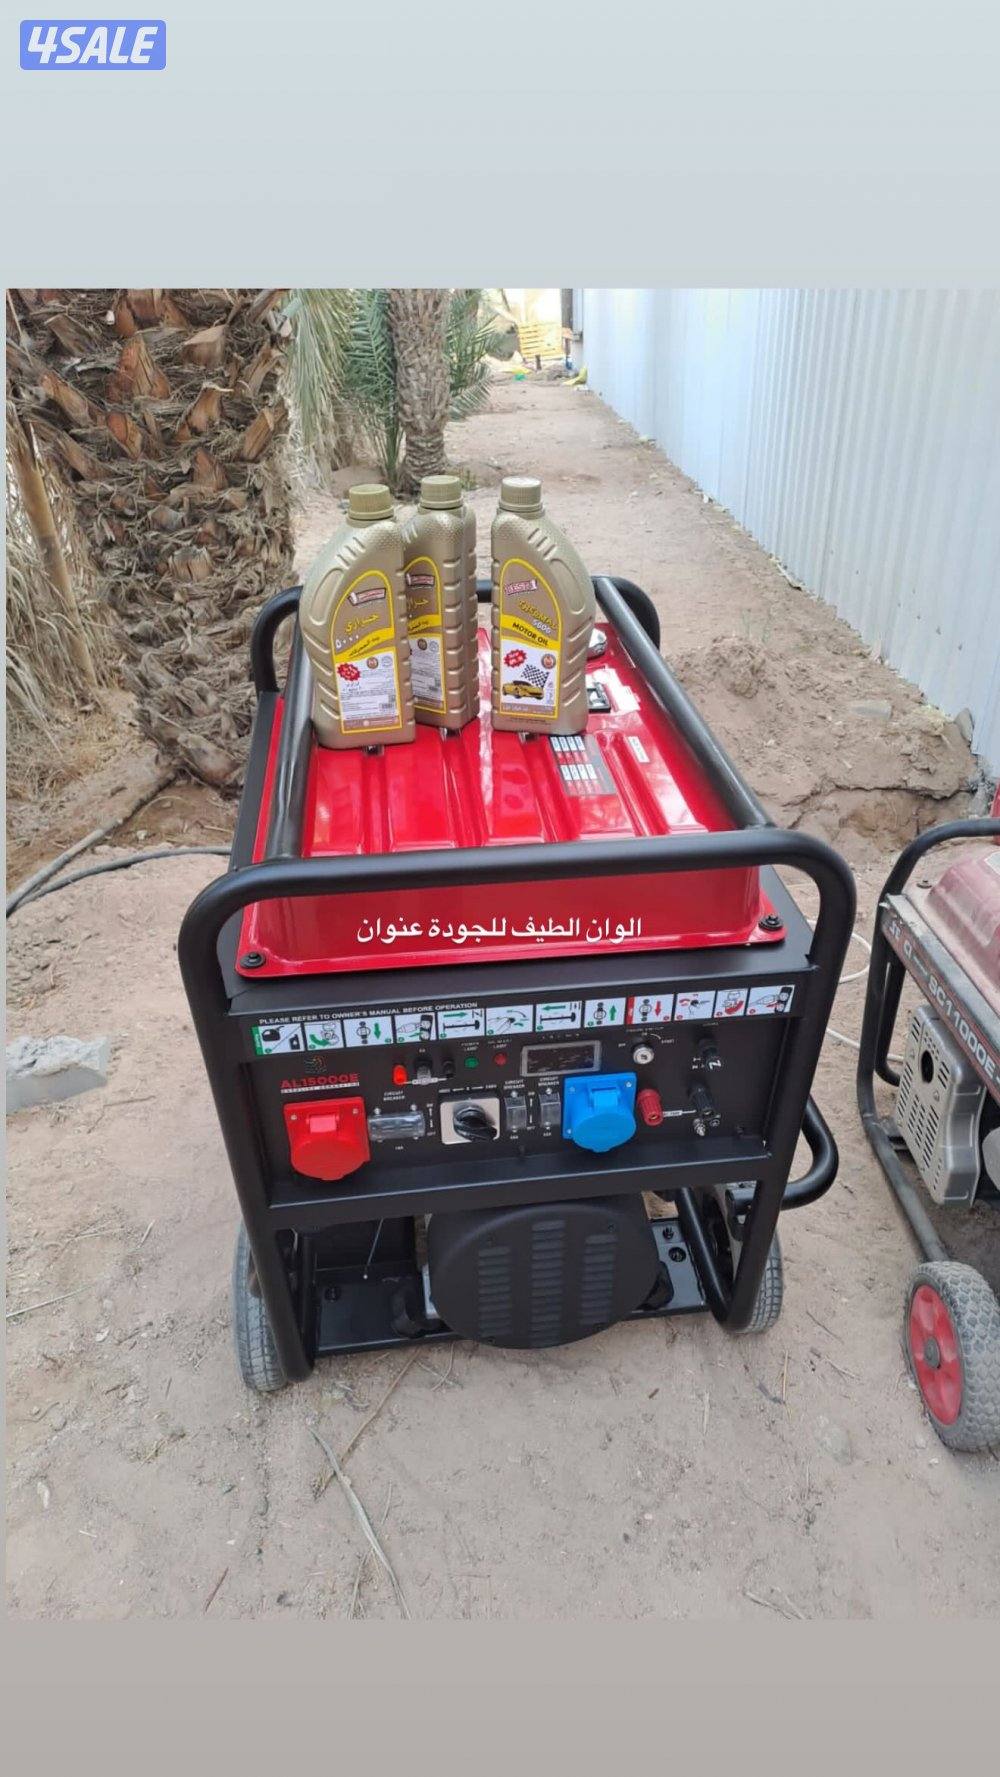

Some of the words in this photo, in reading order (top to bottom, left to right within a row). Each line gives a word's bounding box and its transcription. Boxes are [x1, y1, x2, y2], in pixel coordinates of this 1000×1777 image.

[512, 622, 537, 640] MOTOR
[537, 636, 549, 646] OIL
[259, 1017, 290, 1025] PLEASE
[331, 1011, 368, 1019] OWNER'S
[369, 1008, 401, 1016] MANUAL
[402, 1005, 434, 1013] BEFORE
[435, 1001, 478, 1011] OPERATION
[281, 1073, 358, 1088] AL15000E
